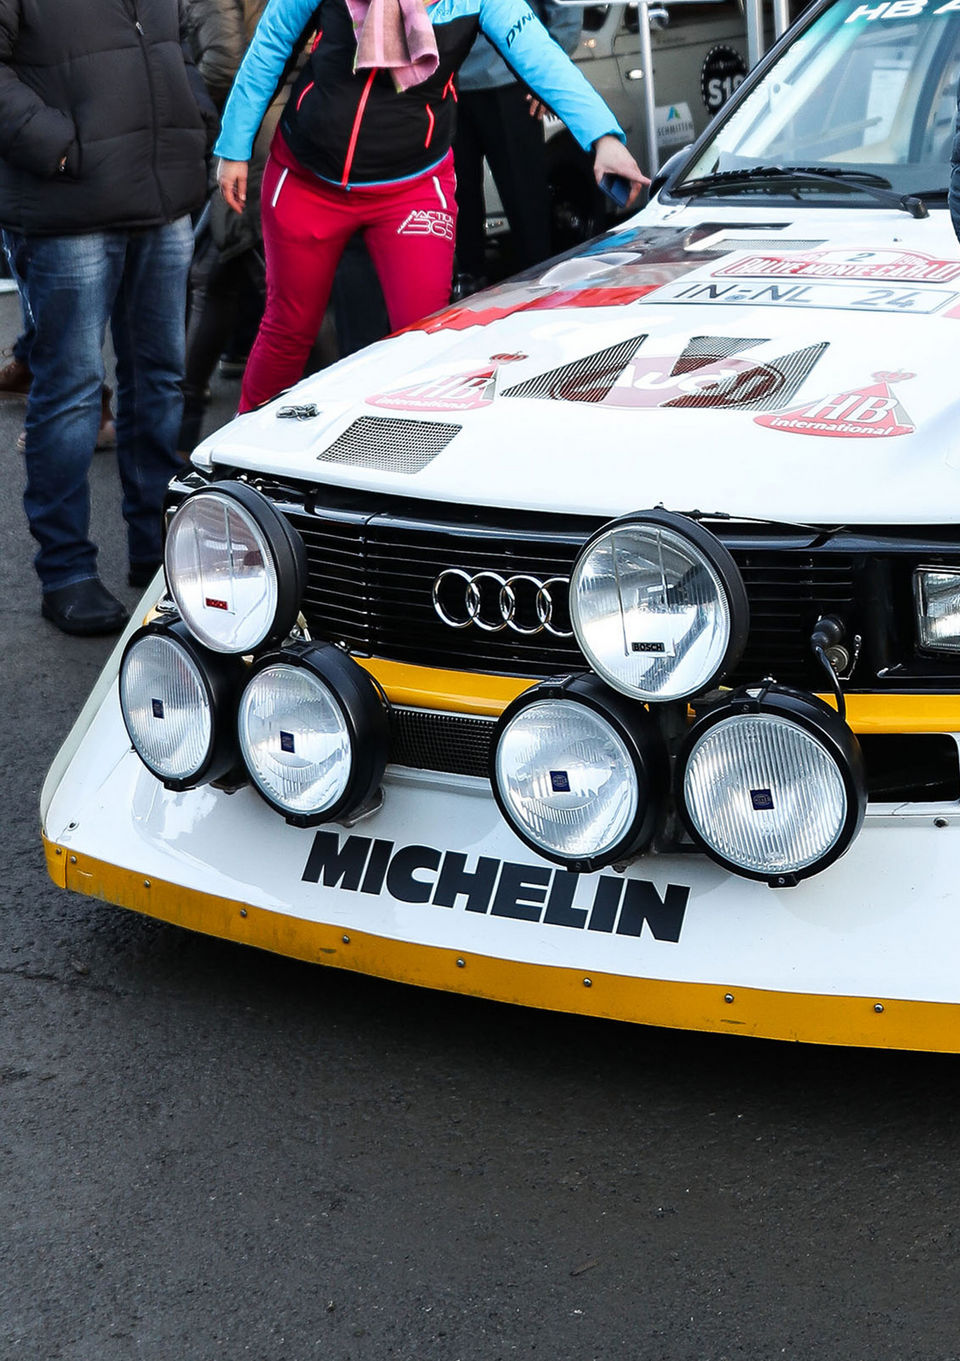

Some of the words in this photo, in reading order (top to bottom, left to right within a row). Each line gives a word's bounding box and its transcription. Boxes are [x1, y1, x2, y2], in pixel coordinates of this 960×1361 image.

[402, 218, 454, 240] 365
[847, 252, 877, 263] 2
[850, 289, 920, 308] 24
[801, 394, 899, 424] HB
[770, 416, 894, 436] international
[631, 642, 665, 653] BOSCH
[301, 830, 691, 944] MICHELIN
